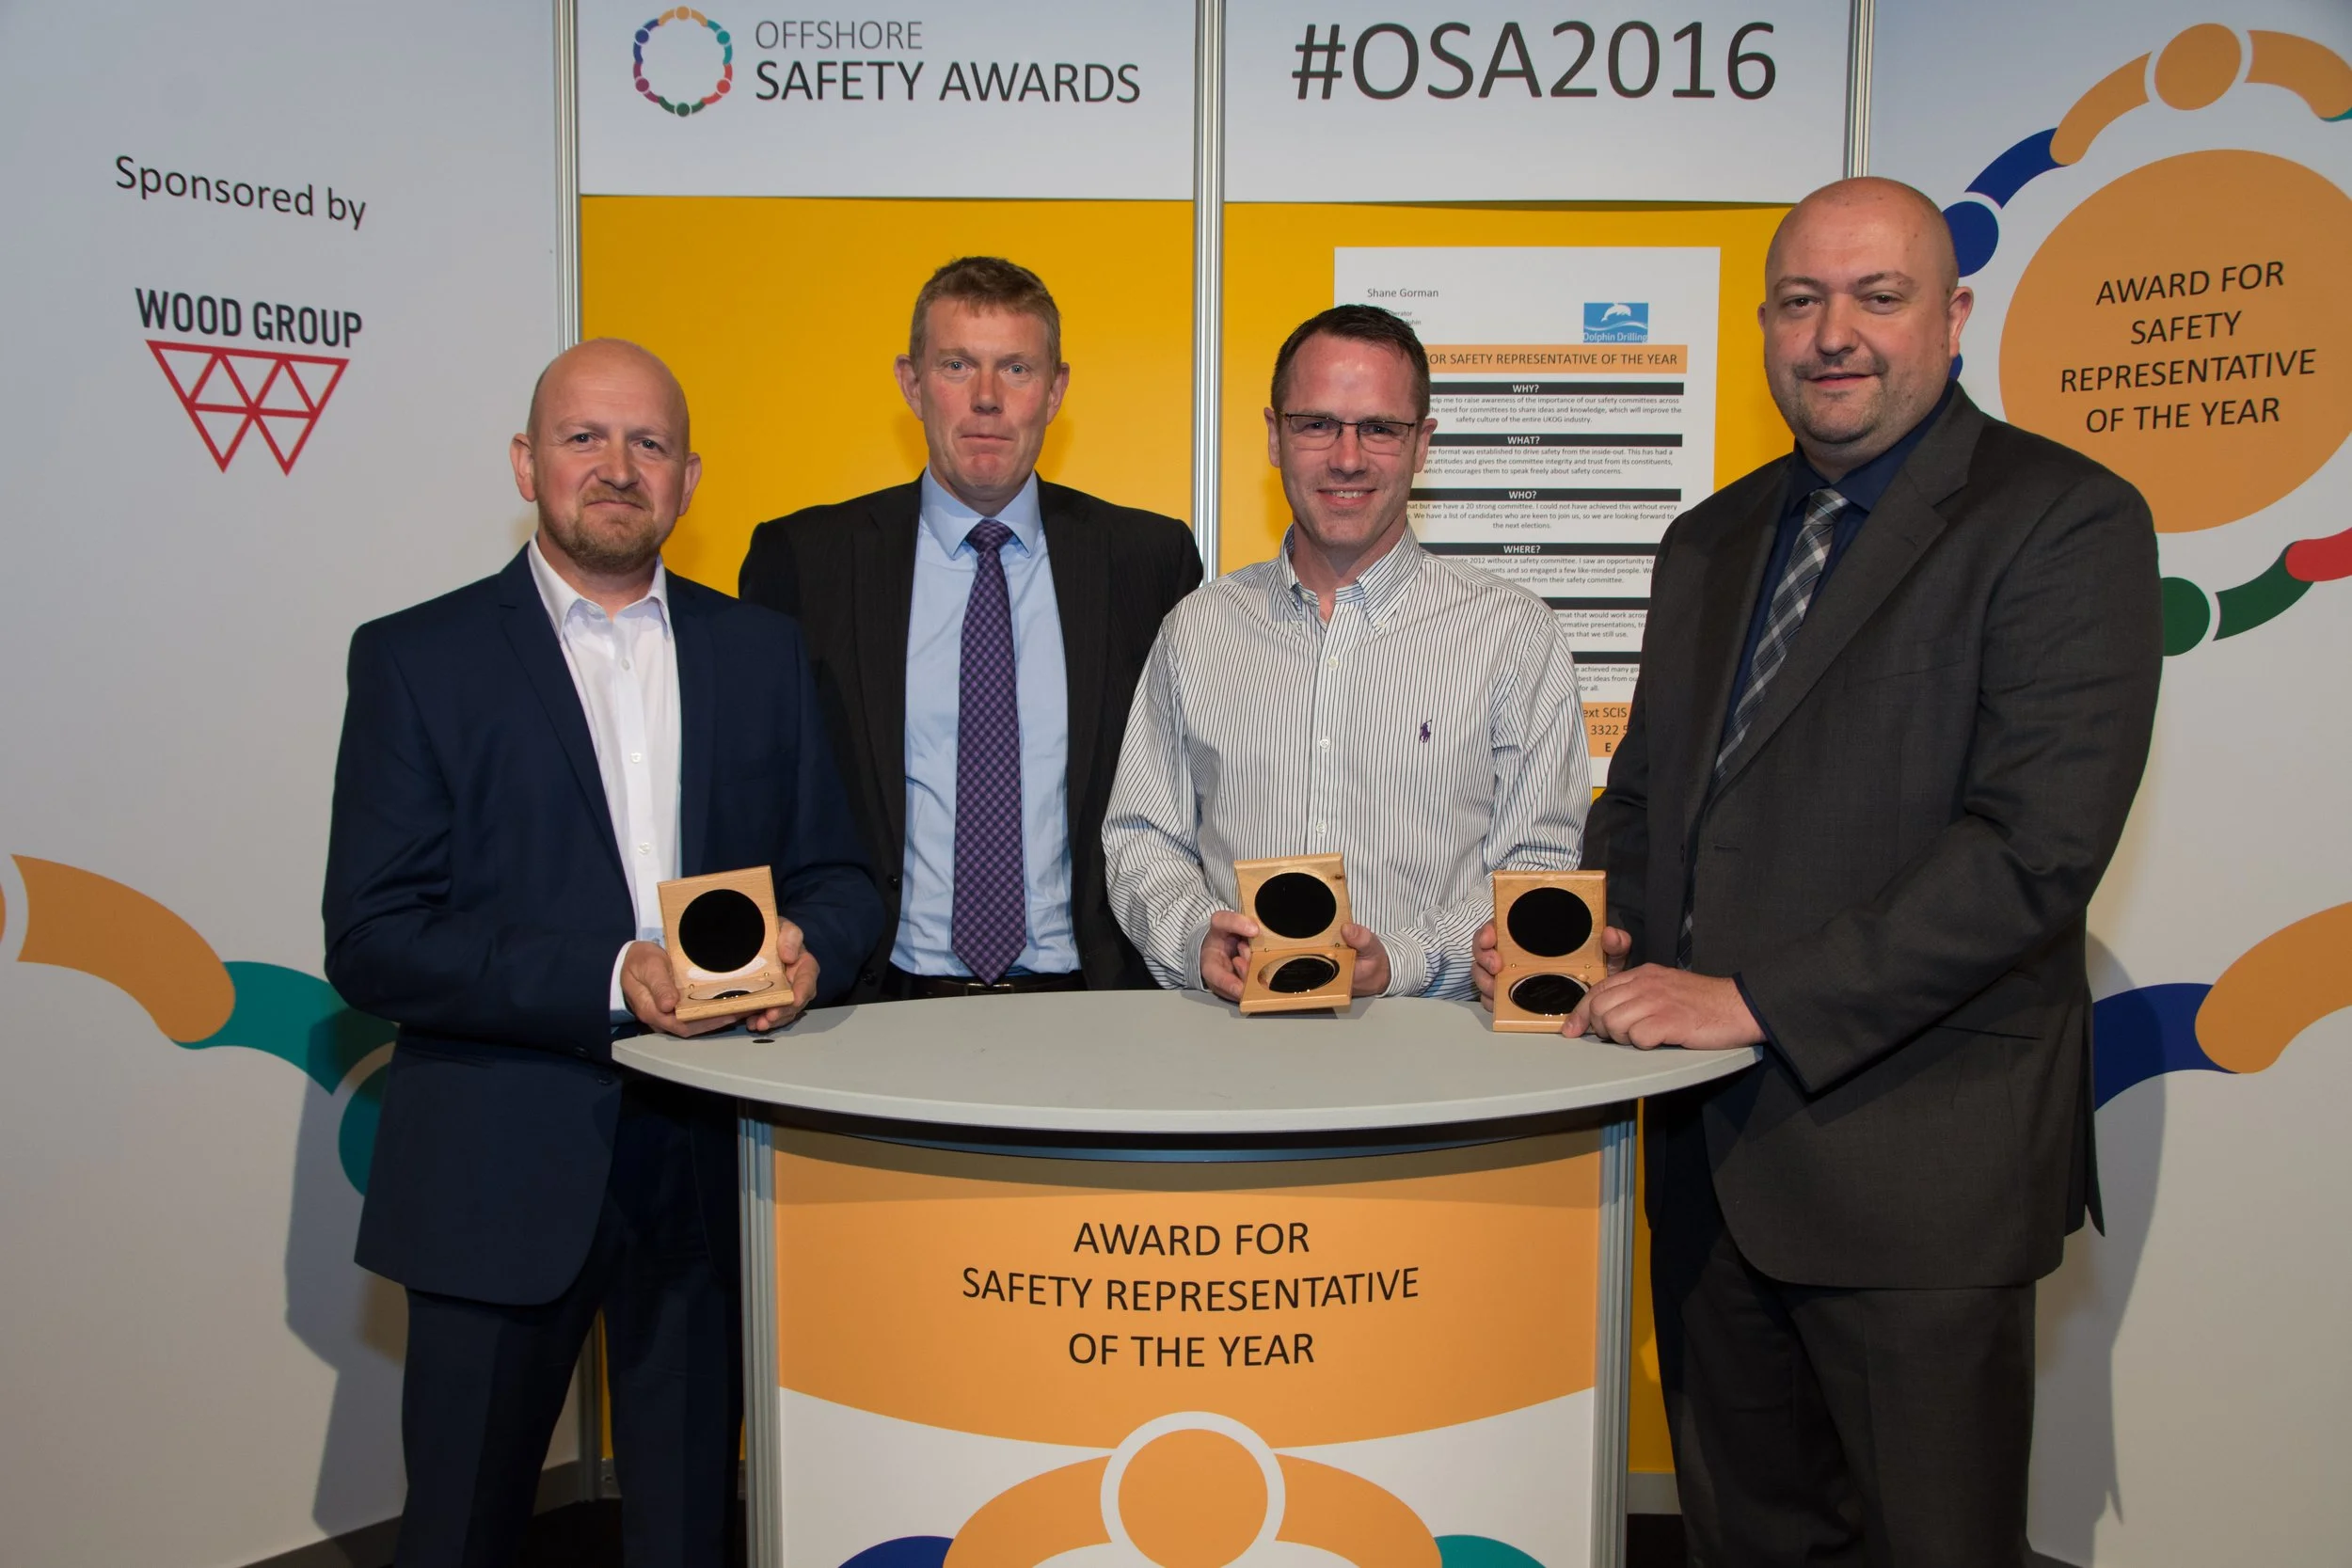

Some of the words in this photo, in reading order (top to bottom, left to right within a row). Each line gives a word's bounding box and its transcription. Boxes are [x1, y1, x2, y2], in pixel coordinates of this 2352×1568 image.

[755, 20, 923, 50] OFFSHORE
[1292, 20, 1776, 101] #OSA2016
[755, 60, 924, 101] SAFETY
[939, 61, 1140, 103] AWARDS
[116, 155, 313, 216] Sponsored
[327, 187, 366, 230] by
[1367, 288, 1397, 297] Shane
[1399, 288, 1438, 297] Gorman
[2095, 270, 2210, 306] AWARD
[2221, 261, 2284, 293] FOR
[135, 288, 242, 337] WOOD
[252, 301, 362, 348] GROUP
[2130, 310, 2242, 345] SAFETY
[1583, 332, 1614, 342] Dolphin
[1617, 332, 1648, 342] Drilling
[1429, 354, 1446, 365] OR
[1450, 354, 1493, 364] SAFETY
[1497, 354, 1597, 364] REPRESENTATIVE
[1601, 354, 1617, 365] OF
[1620, 354, 1643, 365] THE
[1646, 354, 1677, 365] YEAR
[2061, 348, 2316, 393] REPRESENTATIVE
[1513, 384, 1539, 393] WHY?
[1564, 415, 1593, 424] industry.
[2086, 407, 2124, 434] OF
[2133, 403, 2191, 431] THE
[2201, 397, 2280, 426] YEAR
[1507, 436, 1540, 444] WHAT?
[1508, 490, 1537, 499] WHO?
[1503, 545, 1541, 553] WHERE?
[1583, 708, 1599, 718] ext
[1603, 707, 1628, 718] SCIS
[1590, 725, 1619, 736] 3322
[1605, 743, 1611, 752] E
[1073, 1222, 1220, 1257] AWARD
[1236, 1222, 1310, 1256] FOR
[962, 1267, 1093, 1308] SAFETY
[1106, 1266, 1419, 1312] REPRESENTATIVE
[1069, 1333, 1119, 1365] OF
[1130, 1336, 1205, 1368] THE
[1218, 1333, 1314, 1368] YEAR
